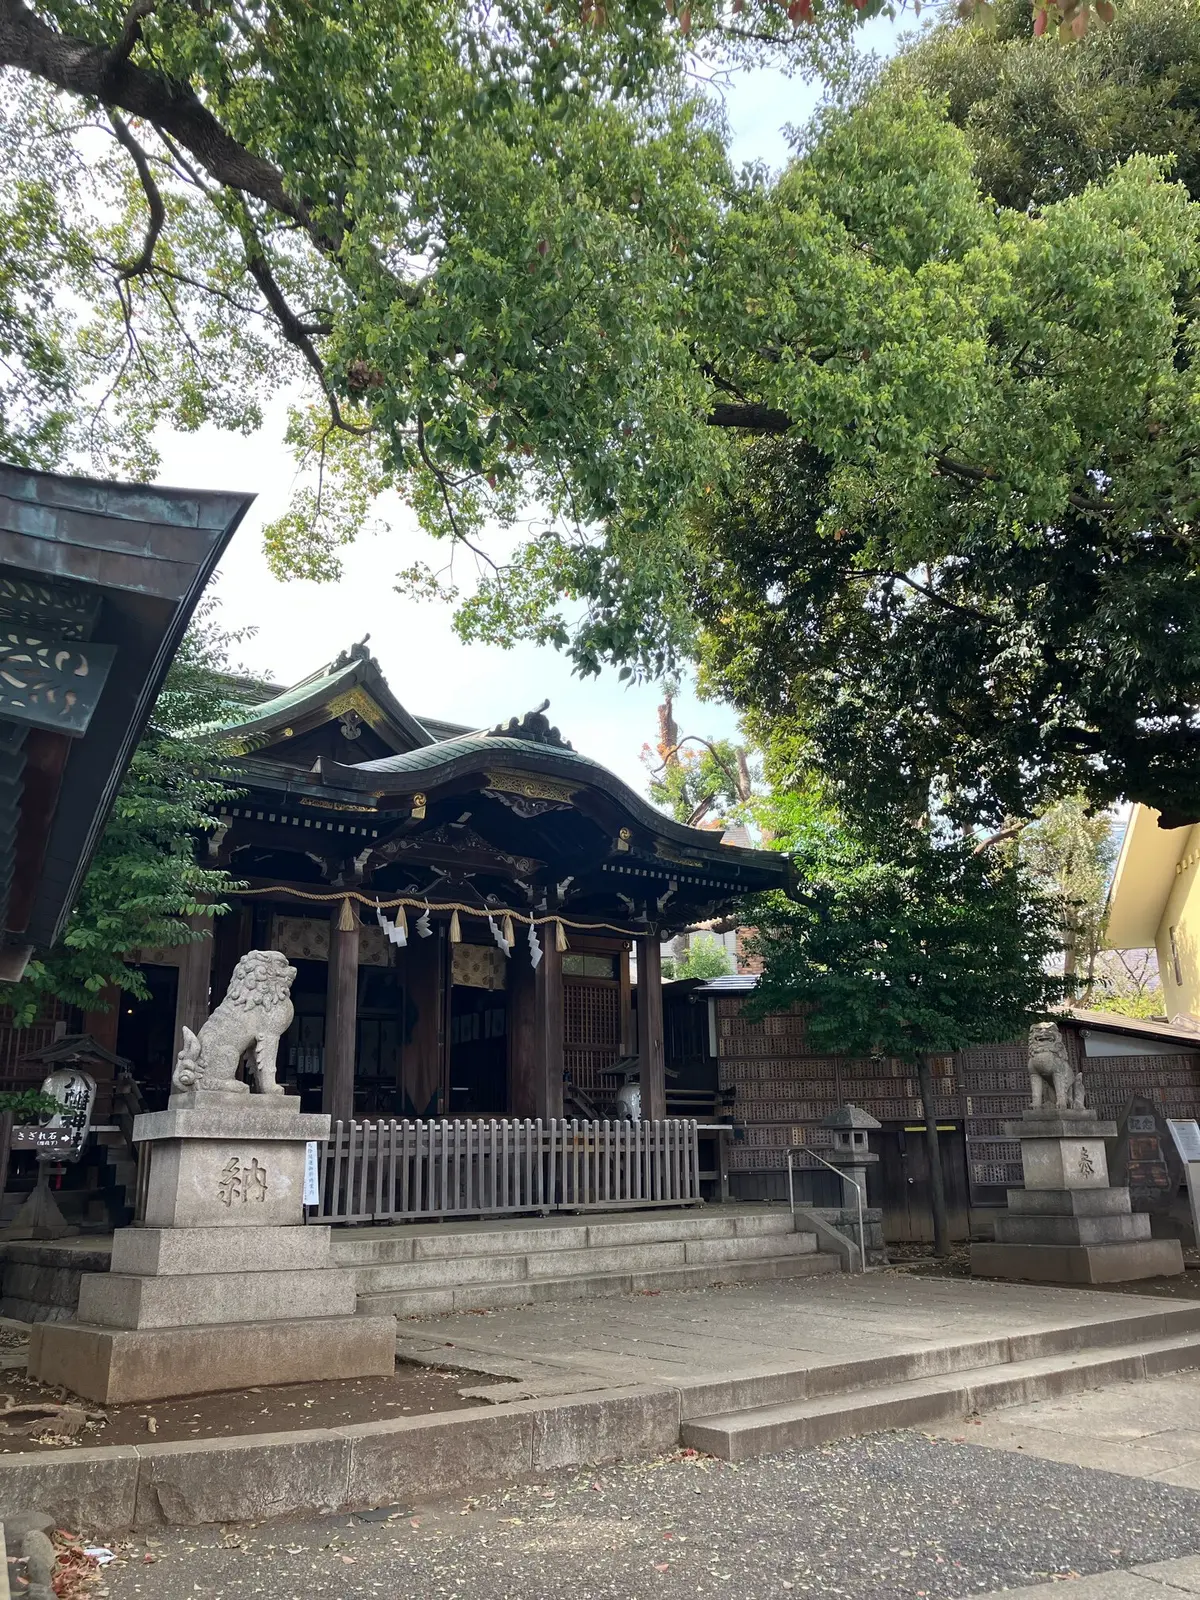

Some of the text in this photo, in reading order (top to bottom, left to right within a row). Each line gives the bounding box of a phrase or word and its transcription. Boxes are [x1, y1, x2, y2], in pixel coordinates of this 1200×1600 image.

[17, 1131, 57, 1141] さざれ石
[217, 1157, 268, 1207] 納
